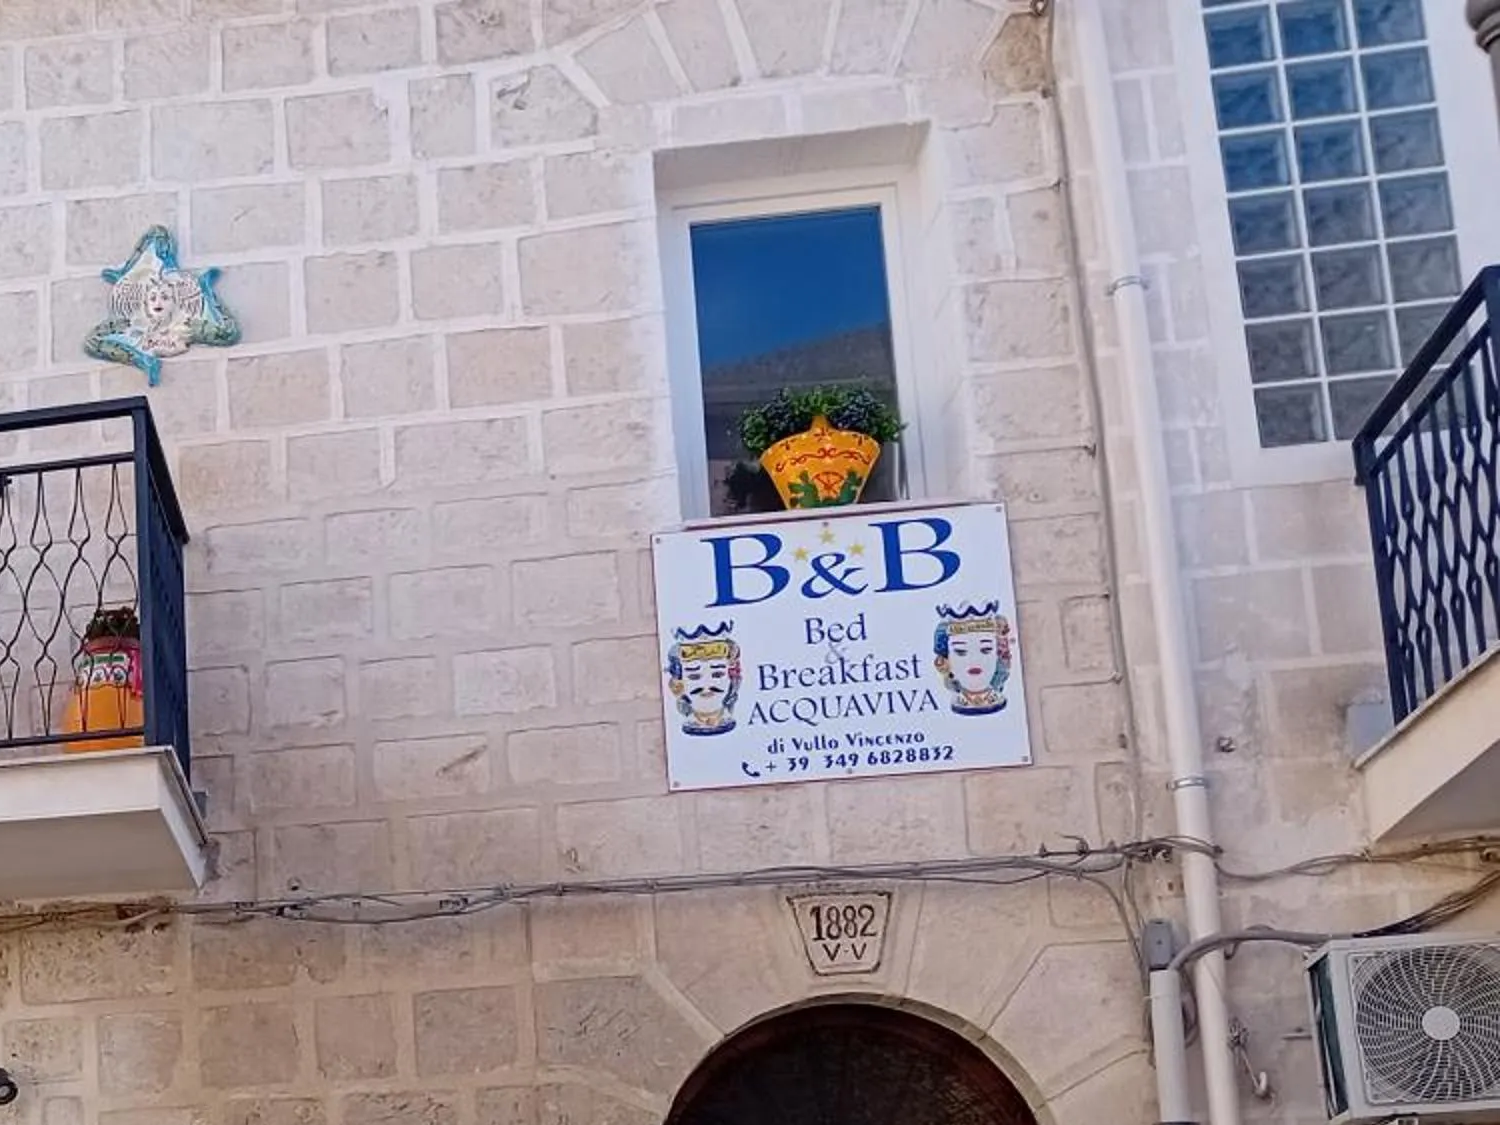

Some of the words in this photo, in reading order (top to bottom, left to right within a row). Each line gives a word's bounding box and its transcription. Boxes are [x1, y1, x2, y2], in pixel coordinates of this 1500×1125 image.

[699, 517, 962, 609] B&B
[804, 612, 868, 645] Bed
[757, 653, 922, 692] Breakfast
[748, 688, 939, 726] ACQUAVIVA
[767, 737, 786, 755] di
[791, 735, 839, 752] Vullo
[787, 756, 810, 773] 39
[825, 752, 860, 770] 349
[867, 745, 954, 767] 6828832
[810, 904, 877, 941] 1882
